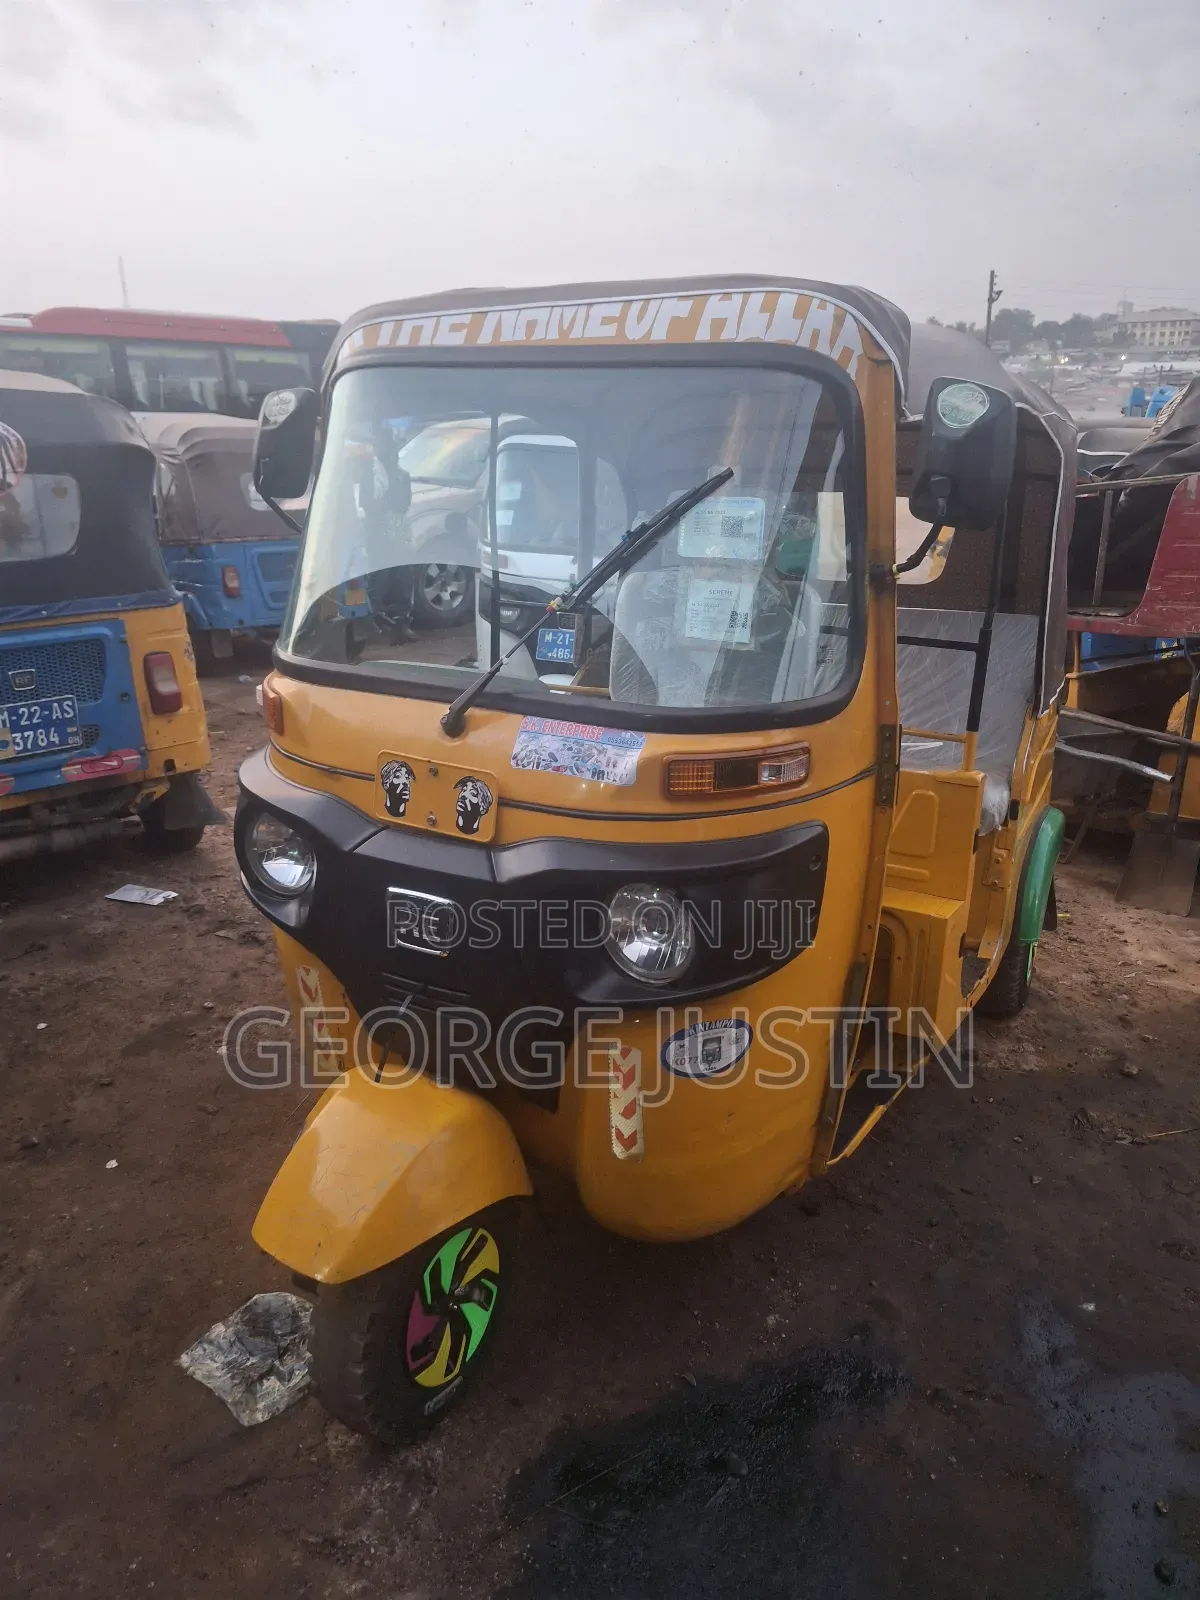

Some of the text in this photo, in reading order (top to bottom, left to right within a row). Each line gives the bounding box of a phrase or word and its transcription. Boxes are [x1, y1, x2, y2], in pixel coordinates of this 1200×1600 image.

[376, 313, 472, 345] THE
[479, 302, 624, 344] NAME
[0, 700, 74, 728] M-22-AS
[11, 727, 60, 751] 3784
[541, 719, 604, 741] ENTERPRISE
